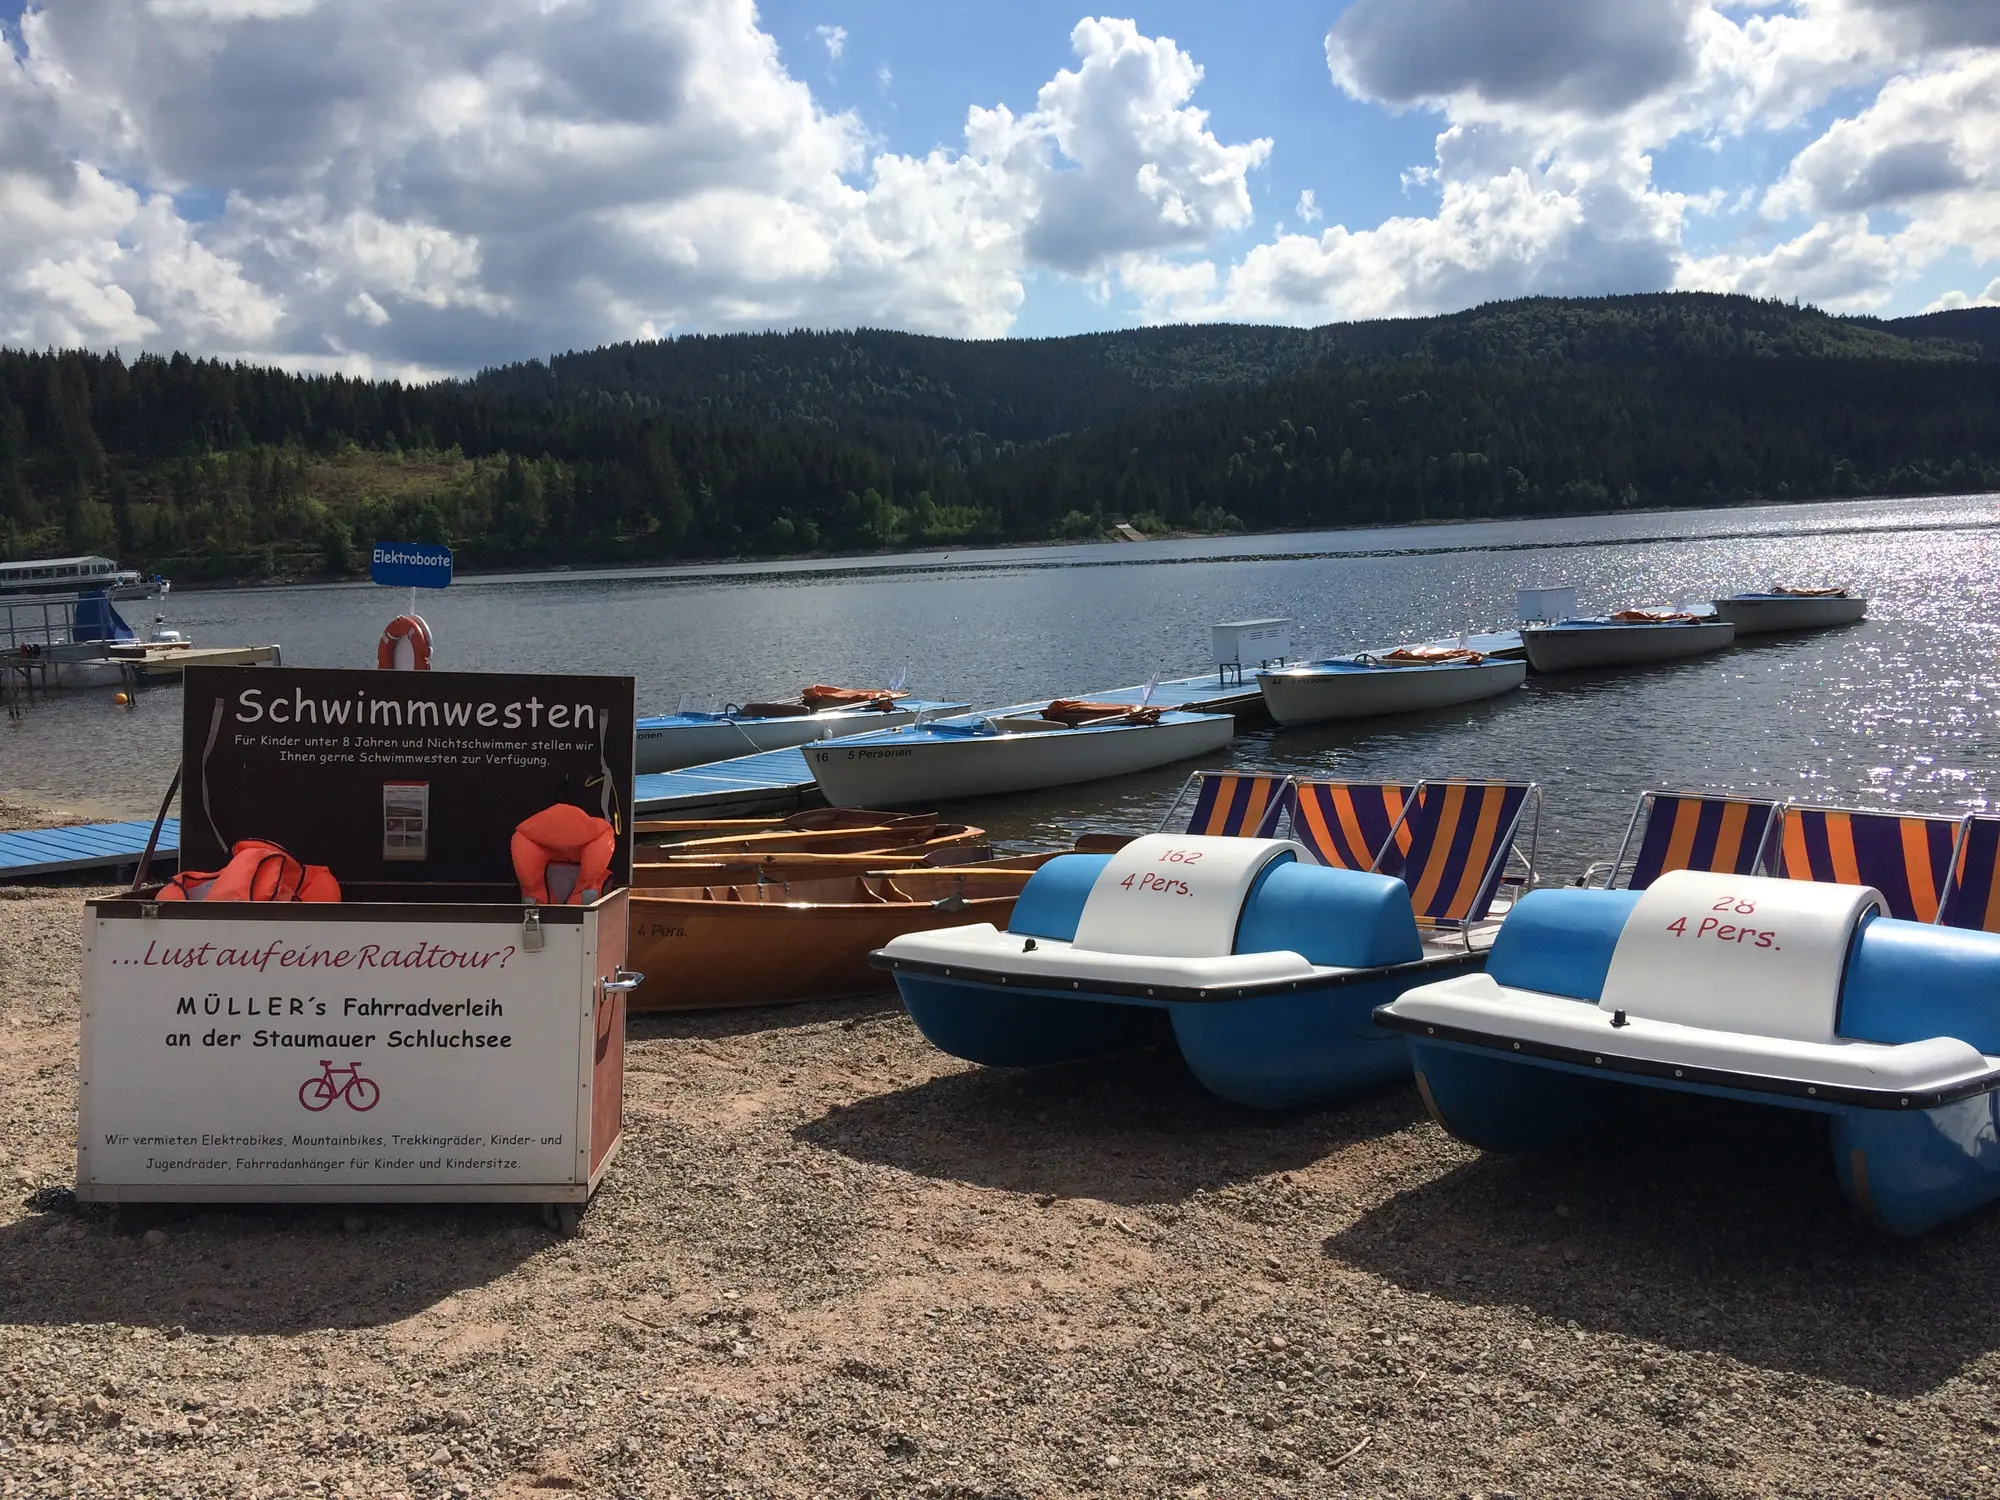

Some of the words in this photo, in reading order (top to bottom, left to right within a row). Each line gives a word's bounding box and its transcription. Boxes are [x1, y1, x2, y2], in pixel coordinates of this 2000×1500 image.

[373, 549, 451, 567] Elektroboote
[235, 687, 595, 730] Schwimmwesten
[234, 734, 256, 746] Für
[260, 735, 300, 747] Kinder
[304, 736, 338, 747] unter
[342, 736, 350, 747] 8
[354, 736, 398, 748] Jahren
[402, 738, 423, 748] und
[427, 738, 528, 750] Nichtschwimmer
[531, 739, 572, 751] stellen
[575, 741, 594, 751] wir
[279, 750, 316, 762] Ihnen
[319, 753, 355, 765] gerne
[359, 752, 457, 764] Schwimmwesten
[461, 755, 481, 764] zur
[485, 754, 550, 768] Verfügung.
[815, 752, 829, 763] 16
[848, 750, 855, 760] 5
[858, 748, 912, 759] Personen
[1158, 849, 1203, 865] 162
[1120, 873, 1136, 891] 4
[1138, 872, 1193, 897] Pers.
[1712, 896, 1756, 914] 28
[637, 924, 646, 937] 4
[651, 924, 687, 937] Pers.
[1666, 916, 1687, 937] 4
[1697, 917, 1780, 951] Pers.
[216, 940, 283, 973] auf
[280, 945, 357, 968] eine
[357, 941, 516, 970] Radtour?
[343, 997, 503, 1017] Fahrradverleih
[165, 1032, 191, 1047] an
[202, 1028, 241, 1047] der
[252, 1030, 376, 1048] Staumauer
[387, 1029, 512, 1048] Schluchsee
[104, 1134, 129, 1145] Wir
[133, 1135, 198, 1146] vermieten
[202, 1135, 287, 1147] Elektrobikes,
[291, 1135, 387, 1147] Mountainbikes,
[391, 1134, 486, 1148] Trekkingräder,
[490, 1134, 536, 1145] Kinder-
[540, 1134, 562, 1145] und
[145, 1158, 231, 1171] Jugendräder,
[236, 1158, 345, 1172] Fahrradanhänger
[350, 1158, 370, 1169] für
[374, 1158, 415, 1169] Kinder
[419, 1158, 441, 1169] und
[446, 1158, 521, 1169] Kindersitze.
